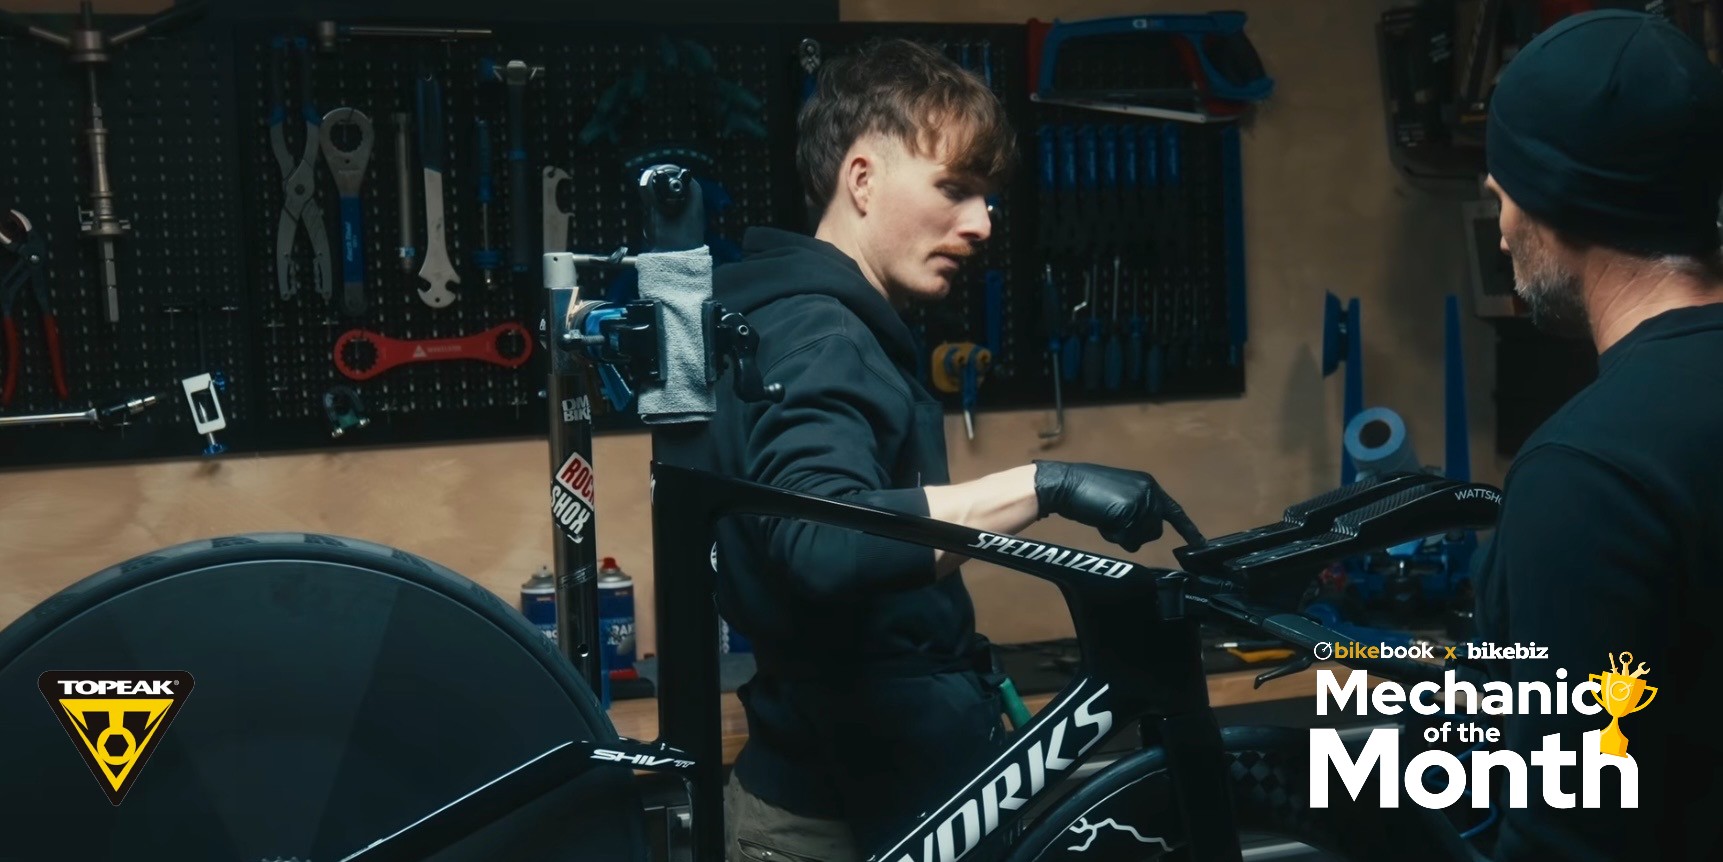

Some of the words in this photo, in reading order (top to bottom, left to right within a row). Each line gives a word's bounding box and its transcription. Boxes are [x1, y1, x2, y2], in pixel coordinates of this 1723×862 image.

[562, 395, 590, 411] DM
[563, 405, 592, 424] BIK
[552, 485, 591, 534] SHOX
[967, 532, 1134, 579] SPECIALIZED
[590, 748, 674, 766] SHIV
